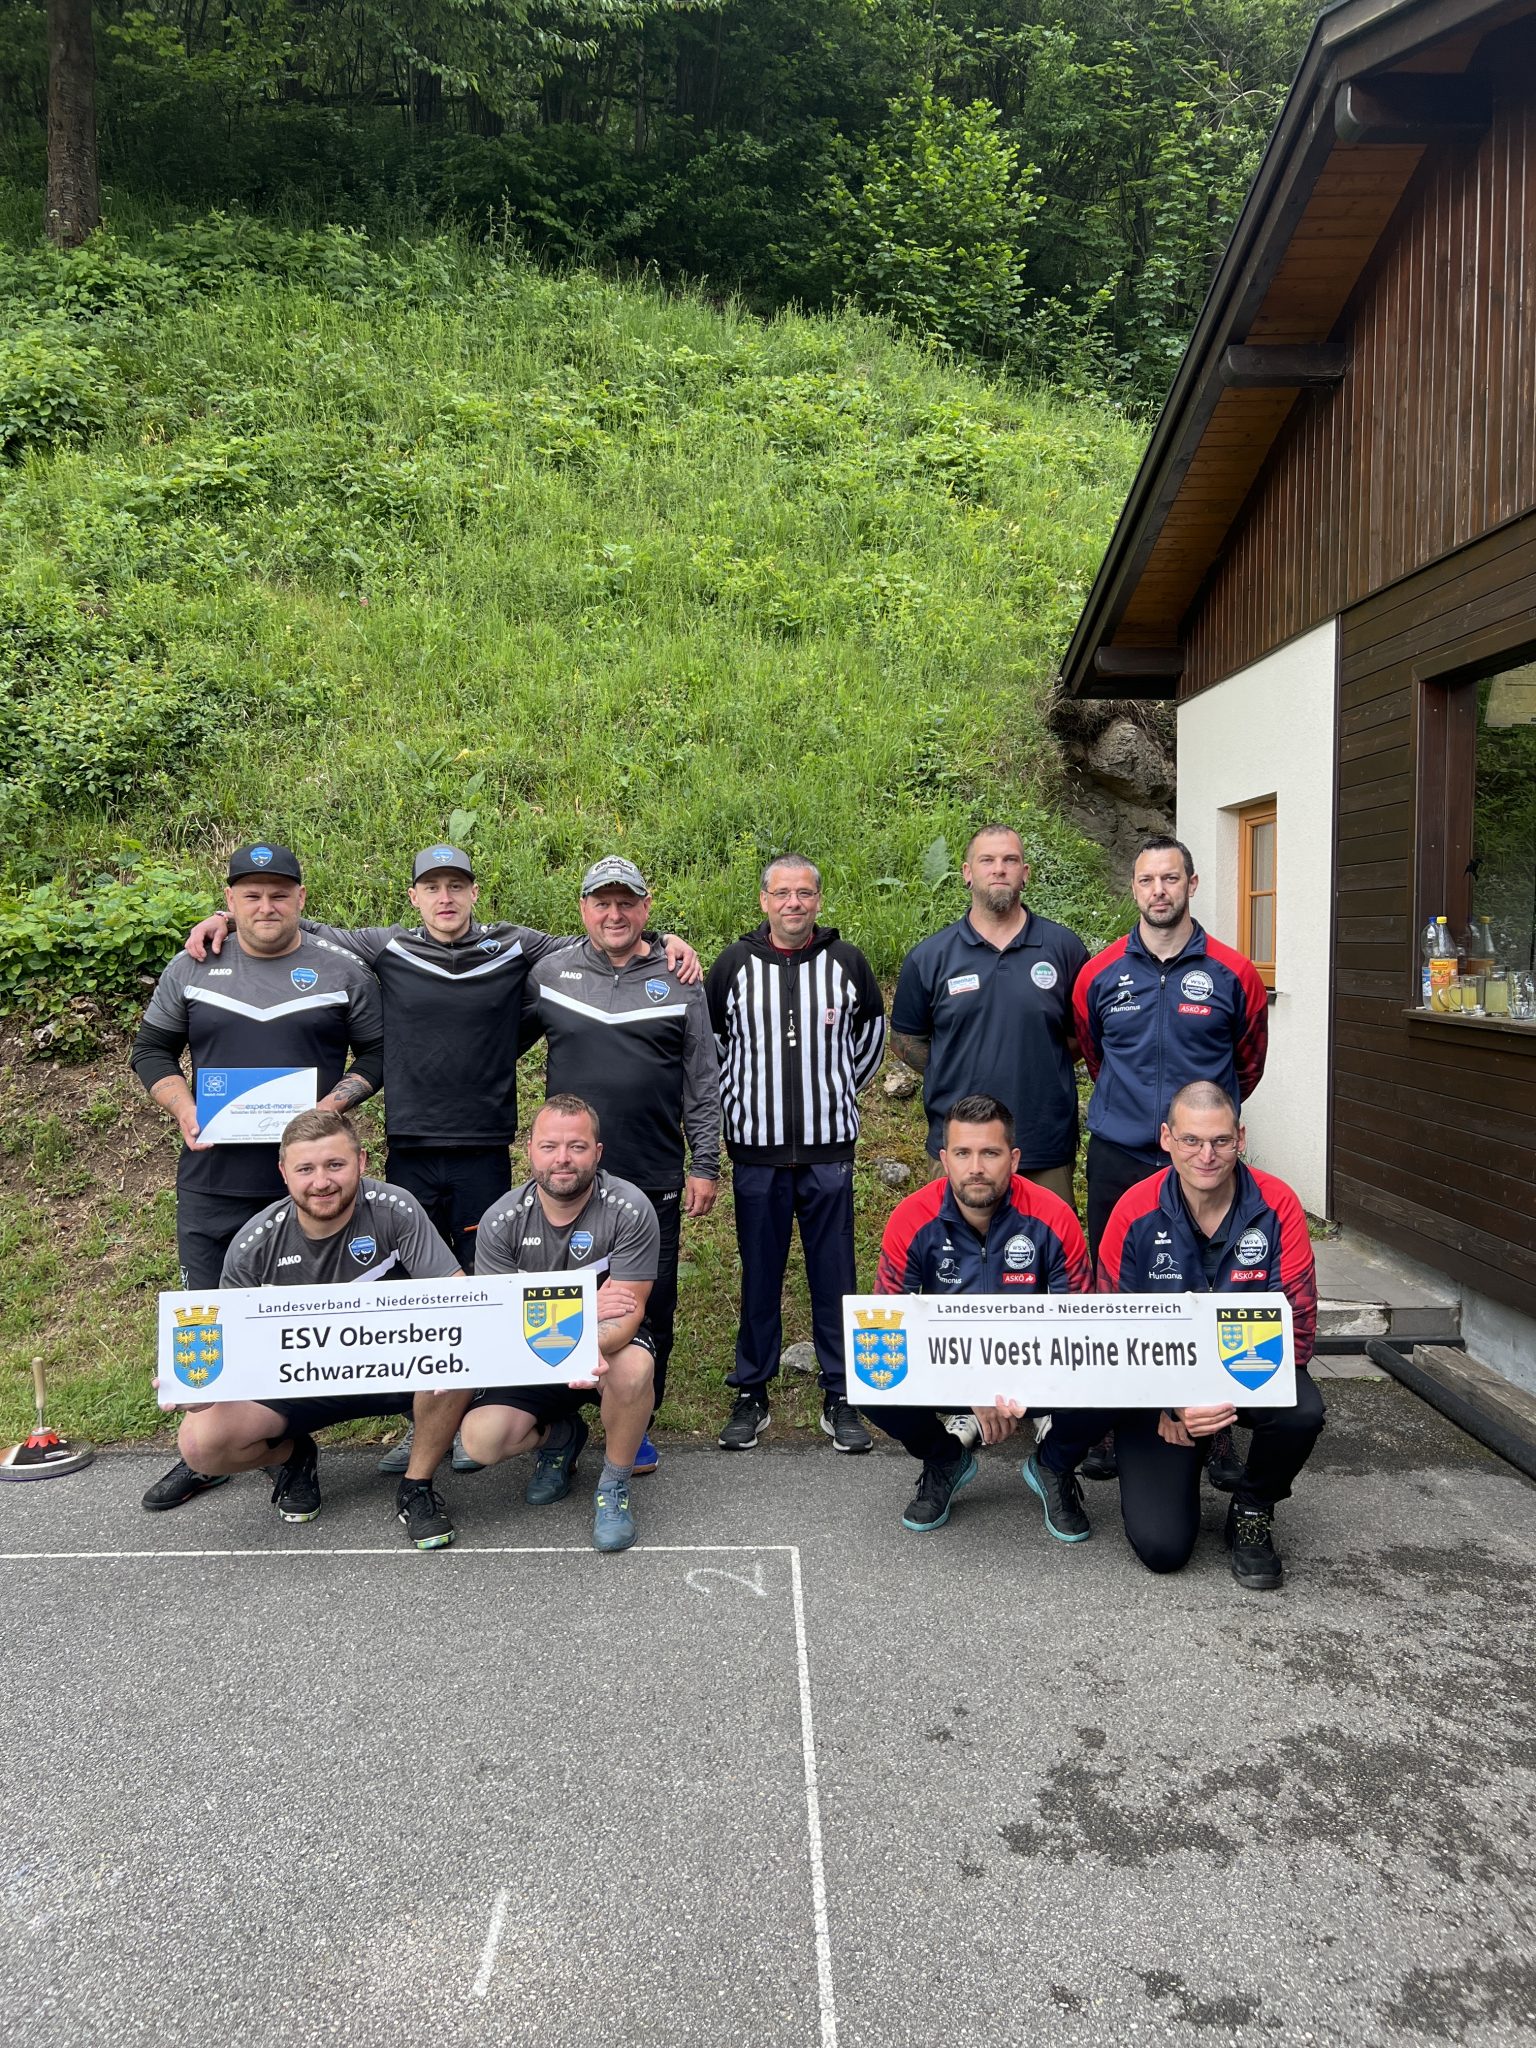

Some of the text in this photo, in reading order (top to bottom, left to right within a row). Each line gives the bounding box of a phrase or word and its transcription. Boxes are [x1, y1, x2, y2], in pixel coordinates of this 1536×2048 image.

[208, 968, 233, 976] JAKO
[559, 970, 583, 980] JAKO
[1110, 1004, 1141, 1013] Humanus
[1180, 1004, 1200, 1013] ASKÖ
[662, 1191, 678, 1201] JAKO
[521, 1236, 542, 1246] AKO
[277, 1254, 302, 1267] JAKO
[1004, 1273, 1025, 1283] ASKÖ
[1148, 1271, 1183, 1280] Humanus
[1232, 1271, 1254, 1280] ASKÖ
[527, 1287, 580, 1299] NÖEV
[258, 1297, 362, 1314] Landesverband
[376, 1291, 489, 1308] Niederösterreich
[937, 1303, 1046, 1314] Landesverband
[1058, 1302, 1182, 1314] Niederösterreich
[1221, 1308, 1278, 1319] NÖEV
[281, 1323, 463, 1350] ESV Obersberg
[928, 1335, 1198, 1371] WSV Voest Alpine Krems
[279, 1353, 470, 1384] Schwarzau/Geb.
